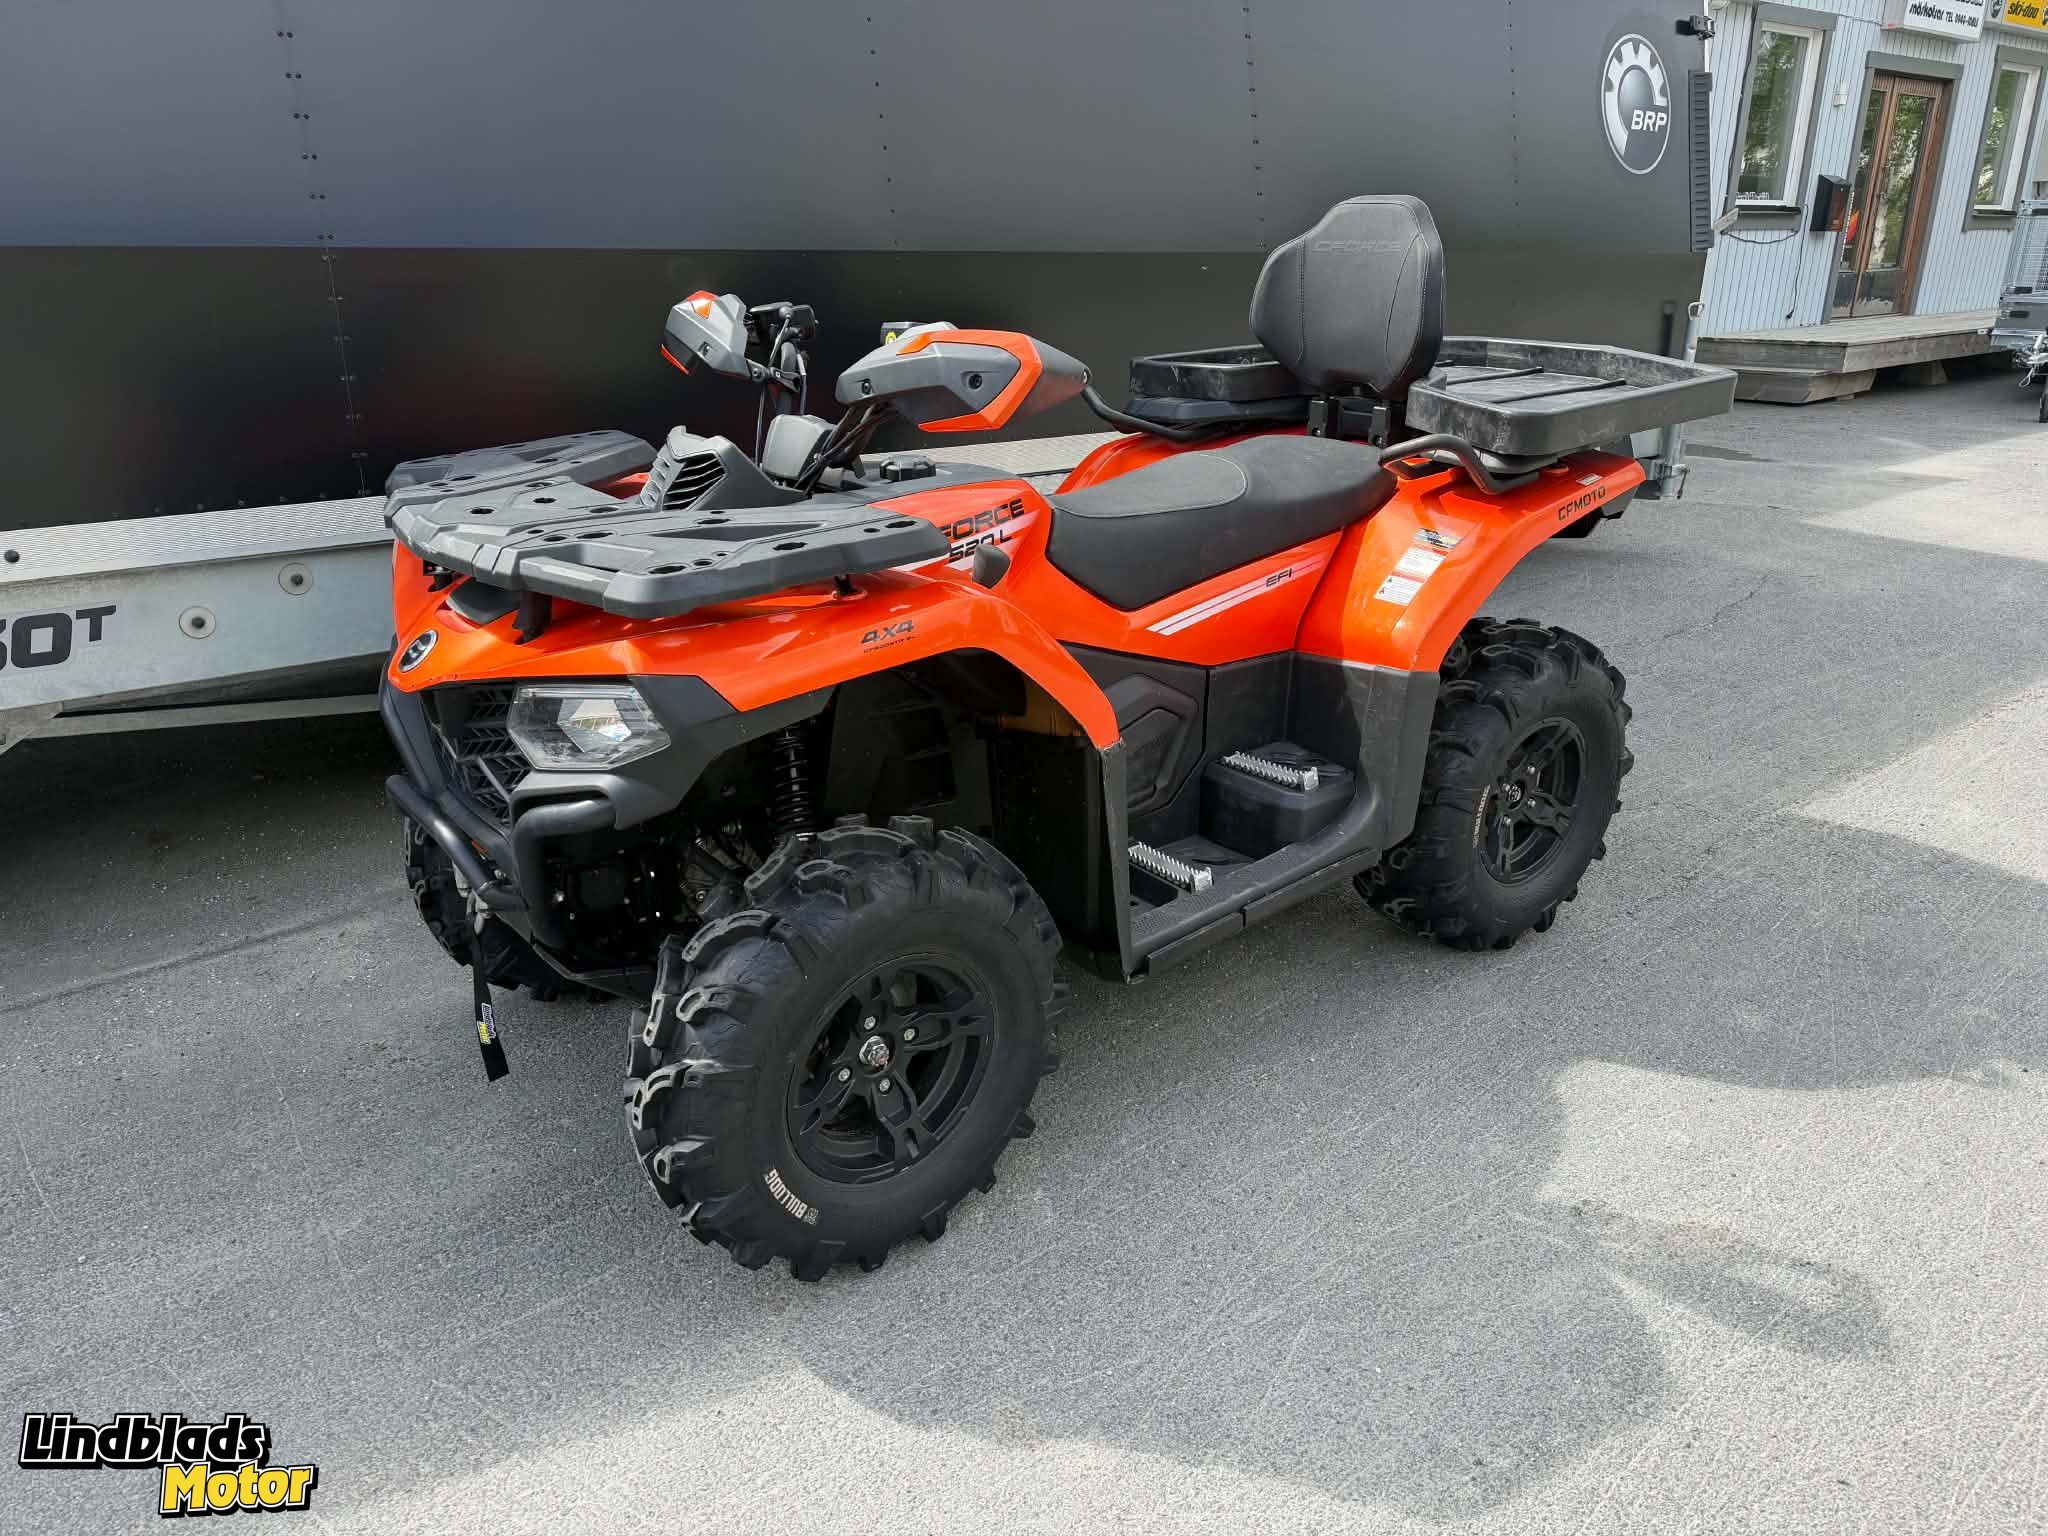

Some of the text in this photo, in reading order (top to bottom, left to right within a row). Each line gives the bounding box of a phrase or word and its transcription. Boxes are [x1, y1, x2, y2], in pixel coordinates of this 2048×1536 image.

[1630, 109, 1668, 133] BRP
[1558, 485, 1606, 521] CFMOTO
[1266, 567, 1293, 587] EFI
[762, 1168, 808, 1219] BULLDOG
